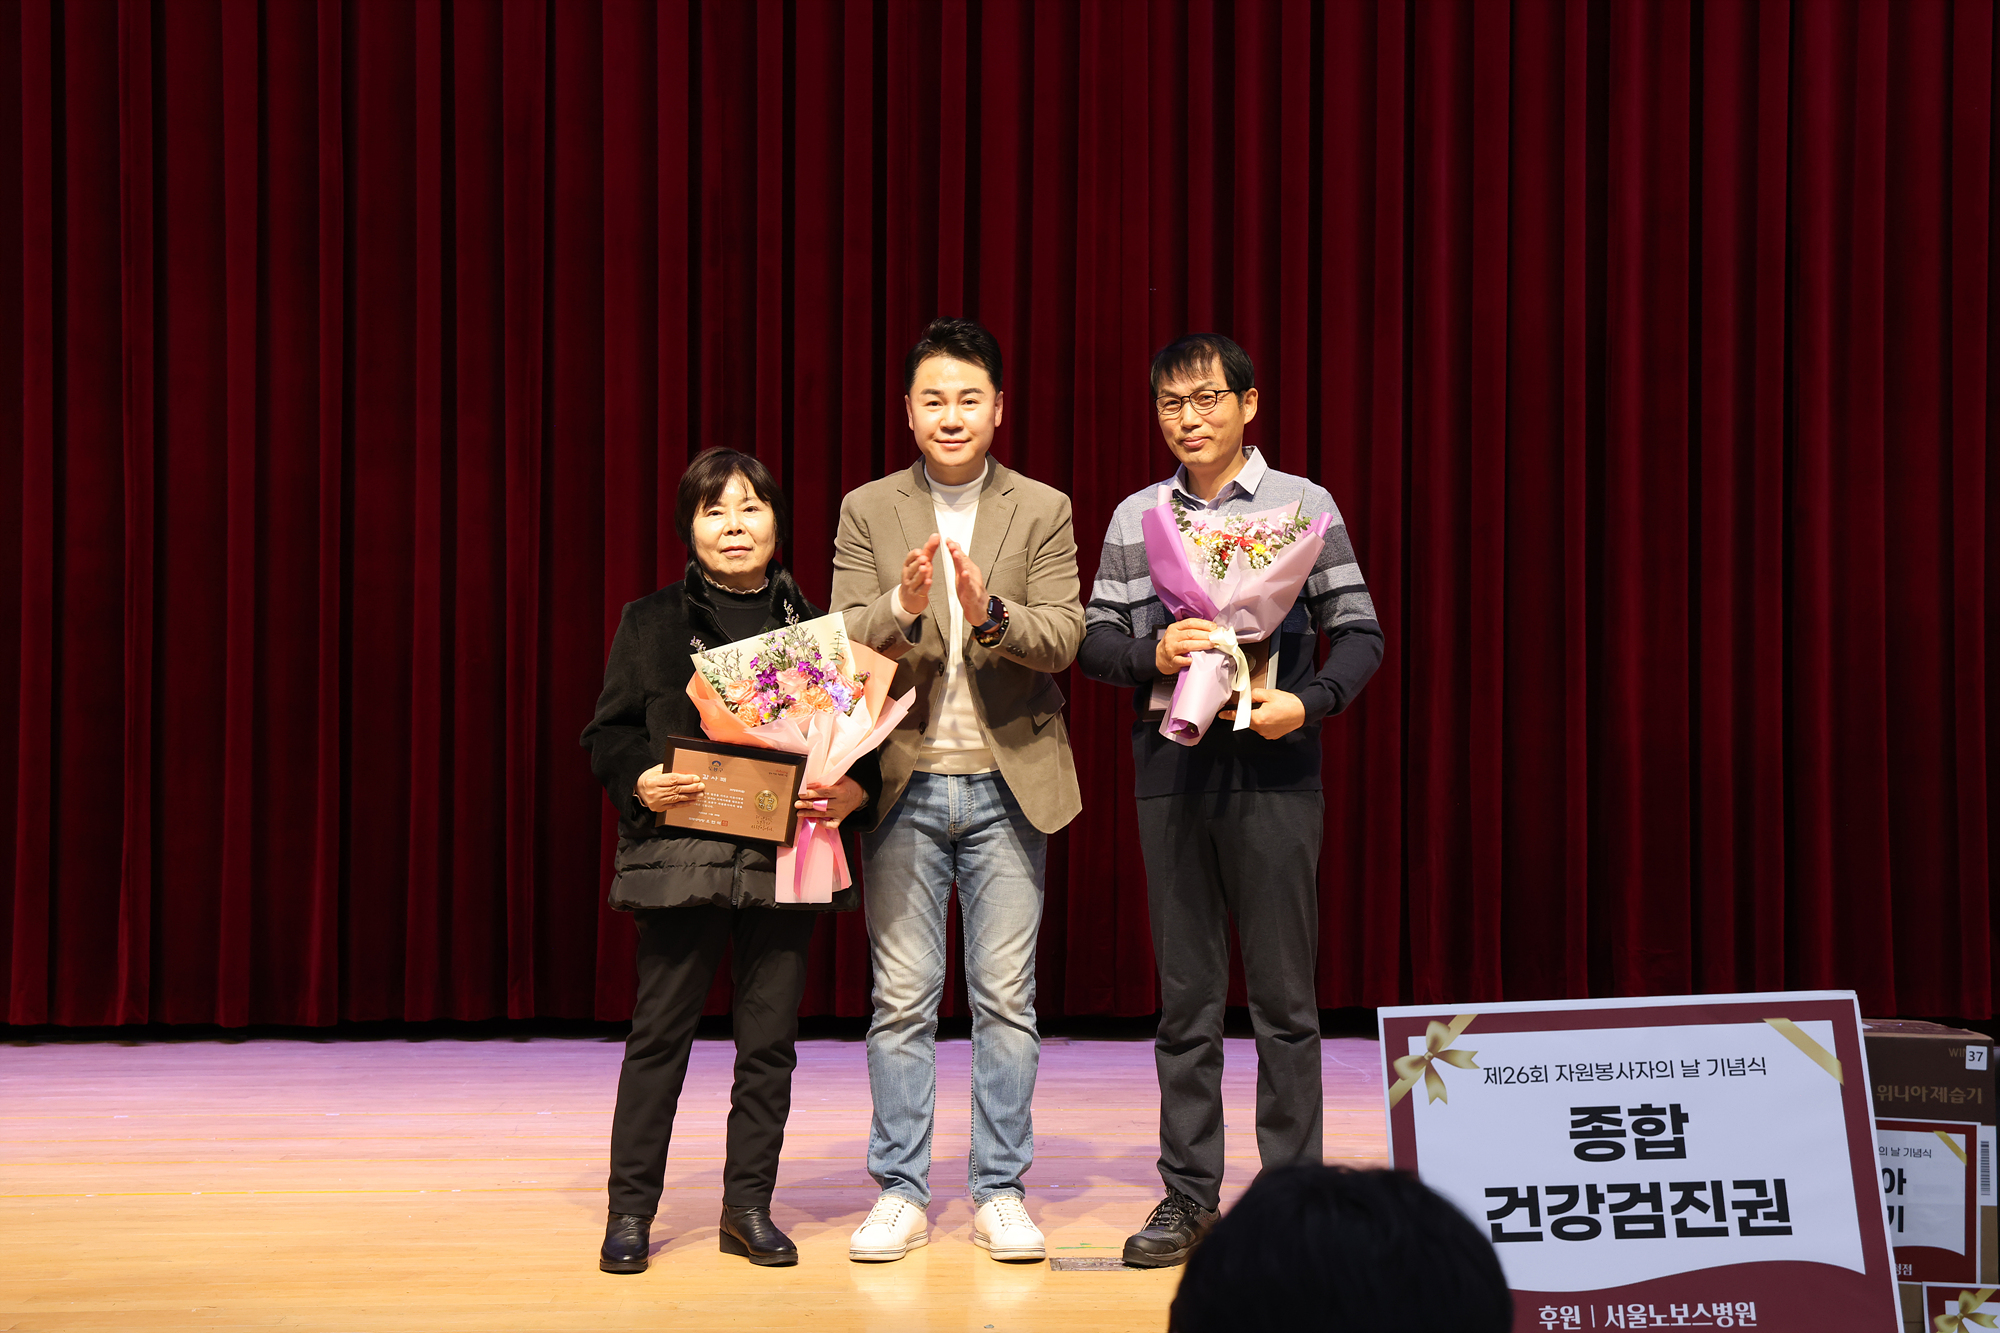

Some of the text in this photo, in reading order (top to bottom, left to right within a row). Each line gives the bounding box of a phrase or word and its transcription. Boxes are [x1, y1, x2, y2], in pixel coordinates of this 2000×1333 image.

[1483, 1056, 1767, 1085] 제26회 자원봉사자의 날 기념식
[1968, 1050, 1984, 1062] 37
[1569, 1103, 1690, 1163] 종합
[1890, 1146, 1901, 1157] 날
[1903, 1147, 1932, 1159] 기념식
[1484, 1178, 1793, 1243] 건강검진권
[1538, 1301, 1758, 1331] 후원 서울노보스병원
